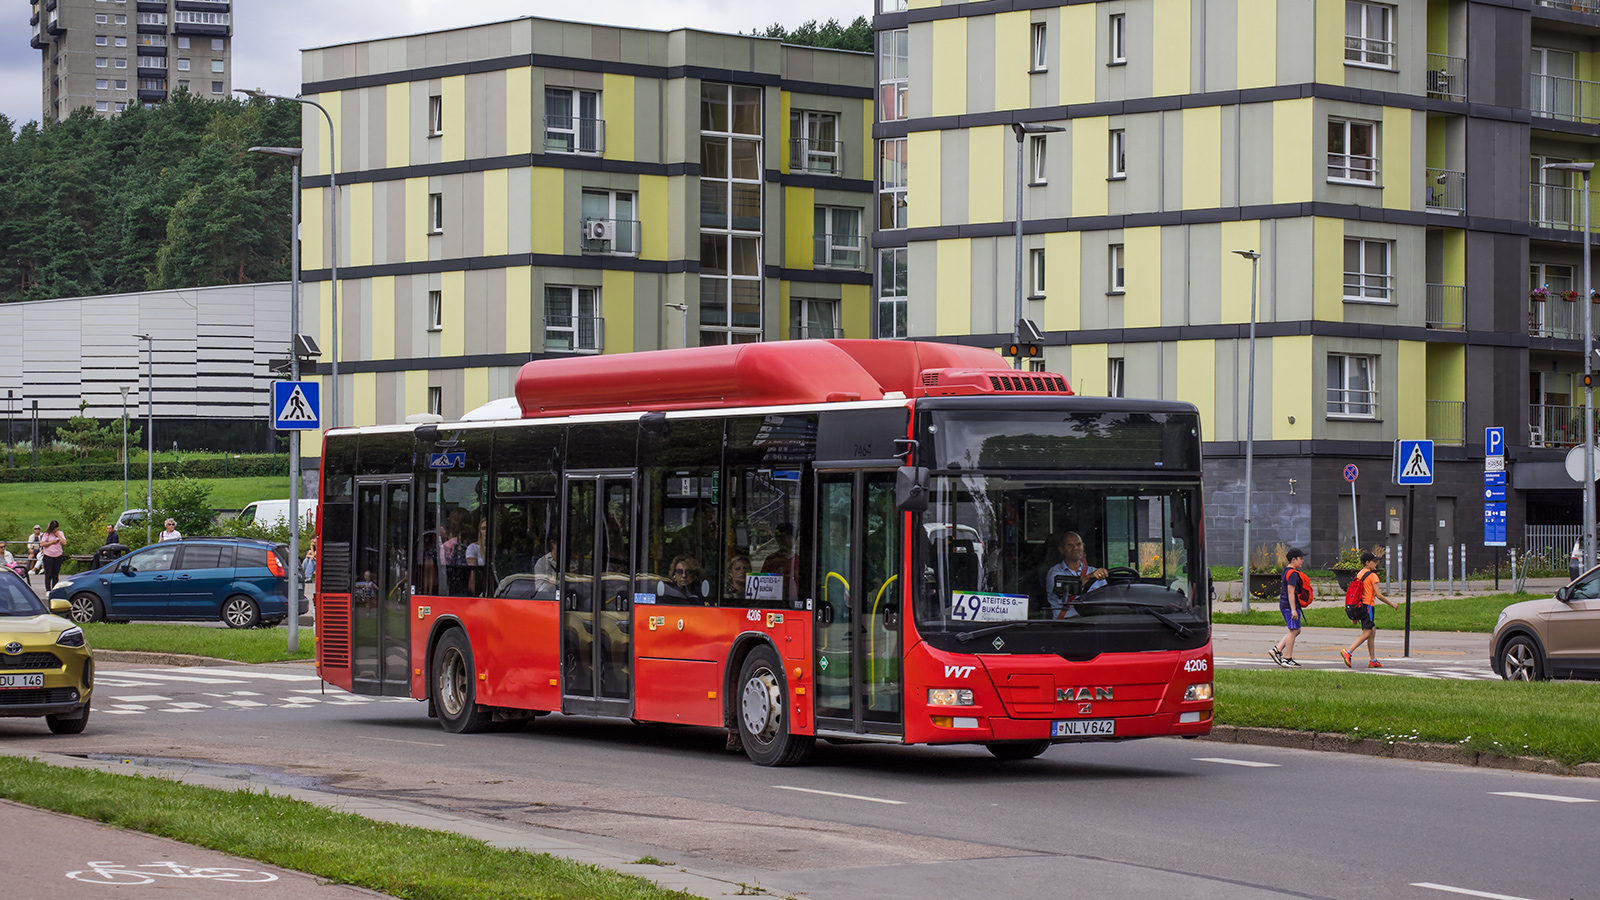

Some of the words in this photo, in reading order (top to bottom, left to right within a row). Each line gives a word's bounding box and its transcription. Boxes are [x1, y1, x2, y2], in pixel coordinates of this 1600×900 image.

[1490, 431, 1501, 453] P
[746, 576, 760, 600] 49
[952, 594, 981, 621] 49
[982, 597, 1011, 605] ATEITIES
[746, 609, 761, 621] 4206
[981, 605, 1009, 614] BUKČIAI
[944, 665, 976, 679] VVT
[1184, 659, 1208, 672] 4206
[0, 676, 15, 686] DU
[23, 675, 42, 686] 146
[1056, 686, 1114, 701] MAN
